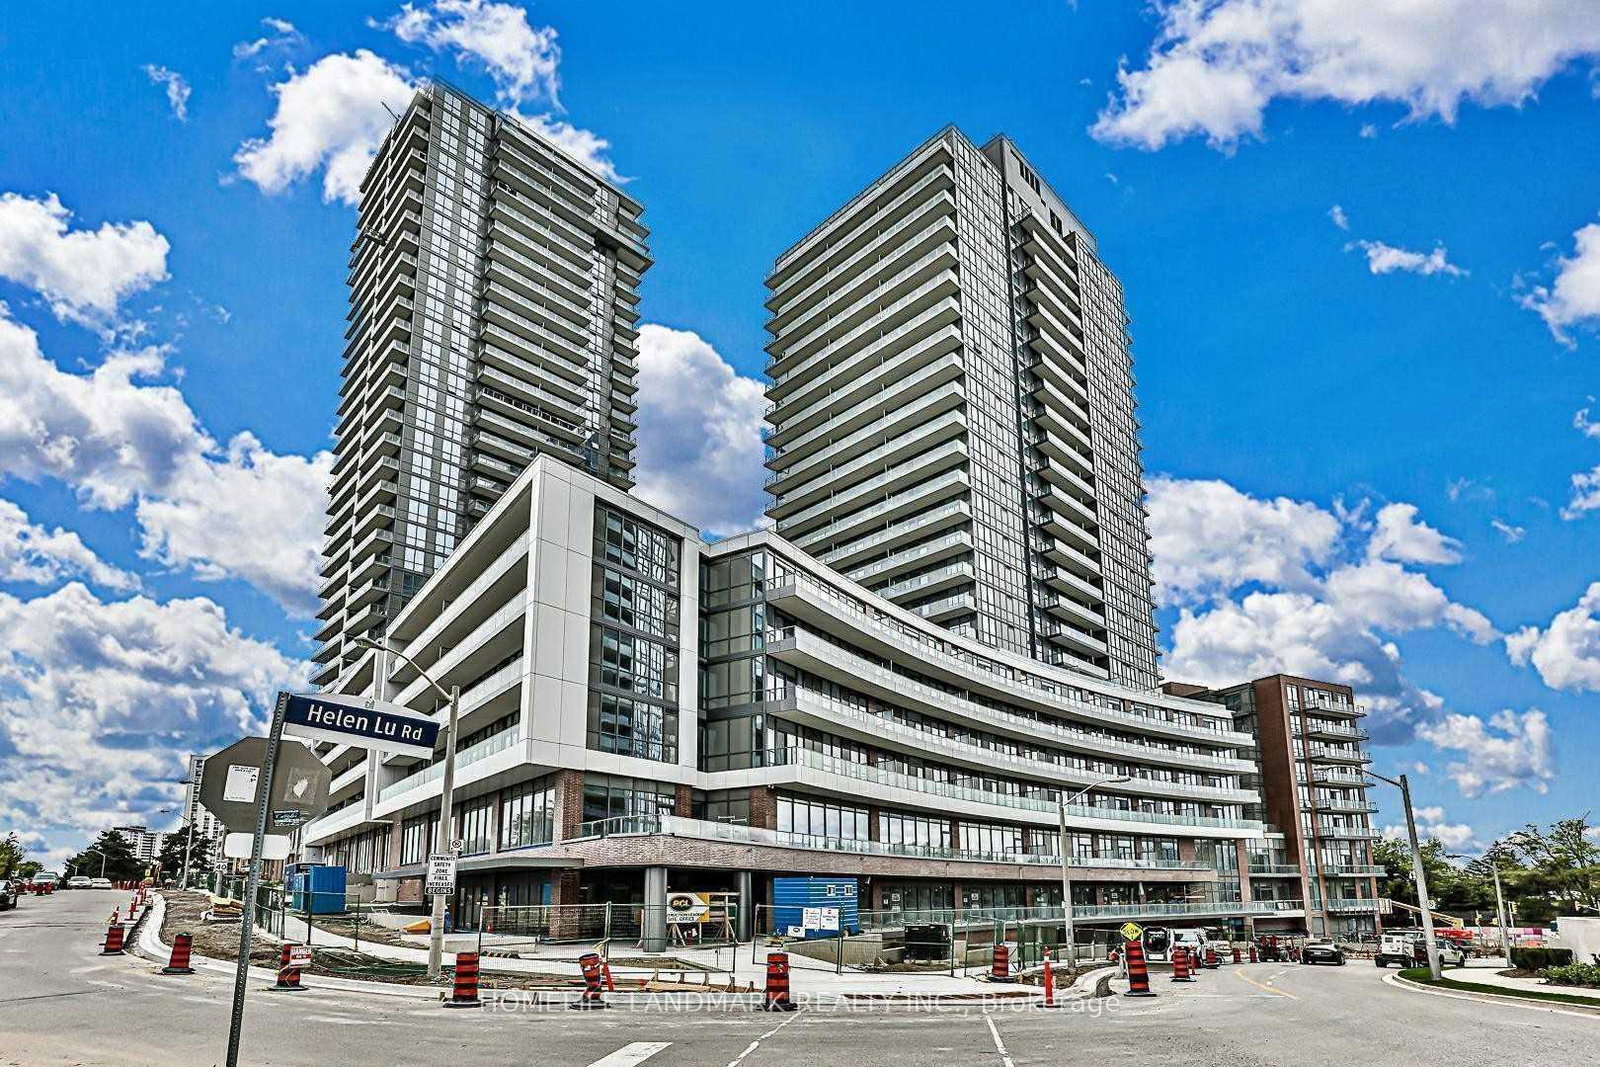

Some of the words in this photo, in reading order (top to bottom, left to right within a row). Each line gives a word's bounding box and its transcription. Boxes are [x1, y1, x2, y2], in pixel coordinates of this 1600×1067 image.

[307, 703, 368, 731] Helen
[374, 716, 397, 736] Lu
[401, 724, 423, 741] Rd
